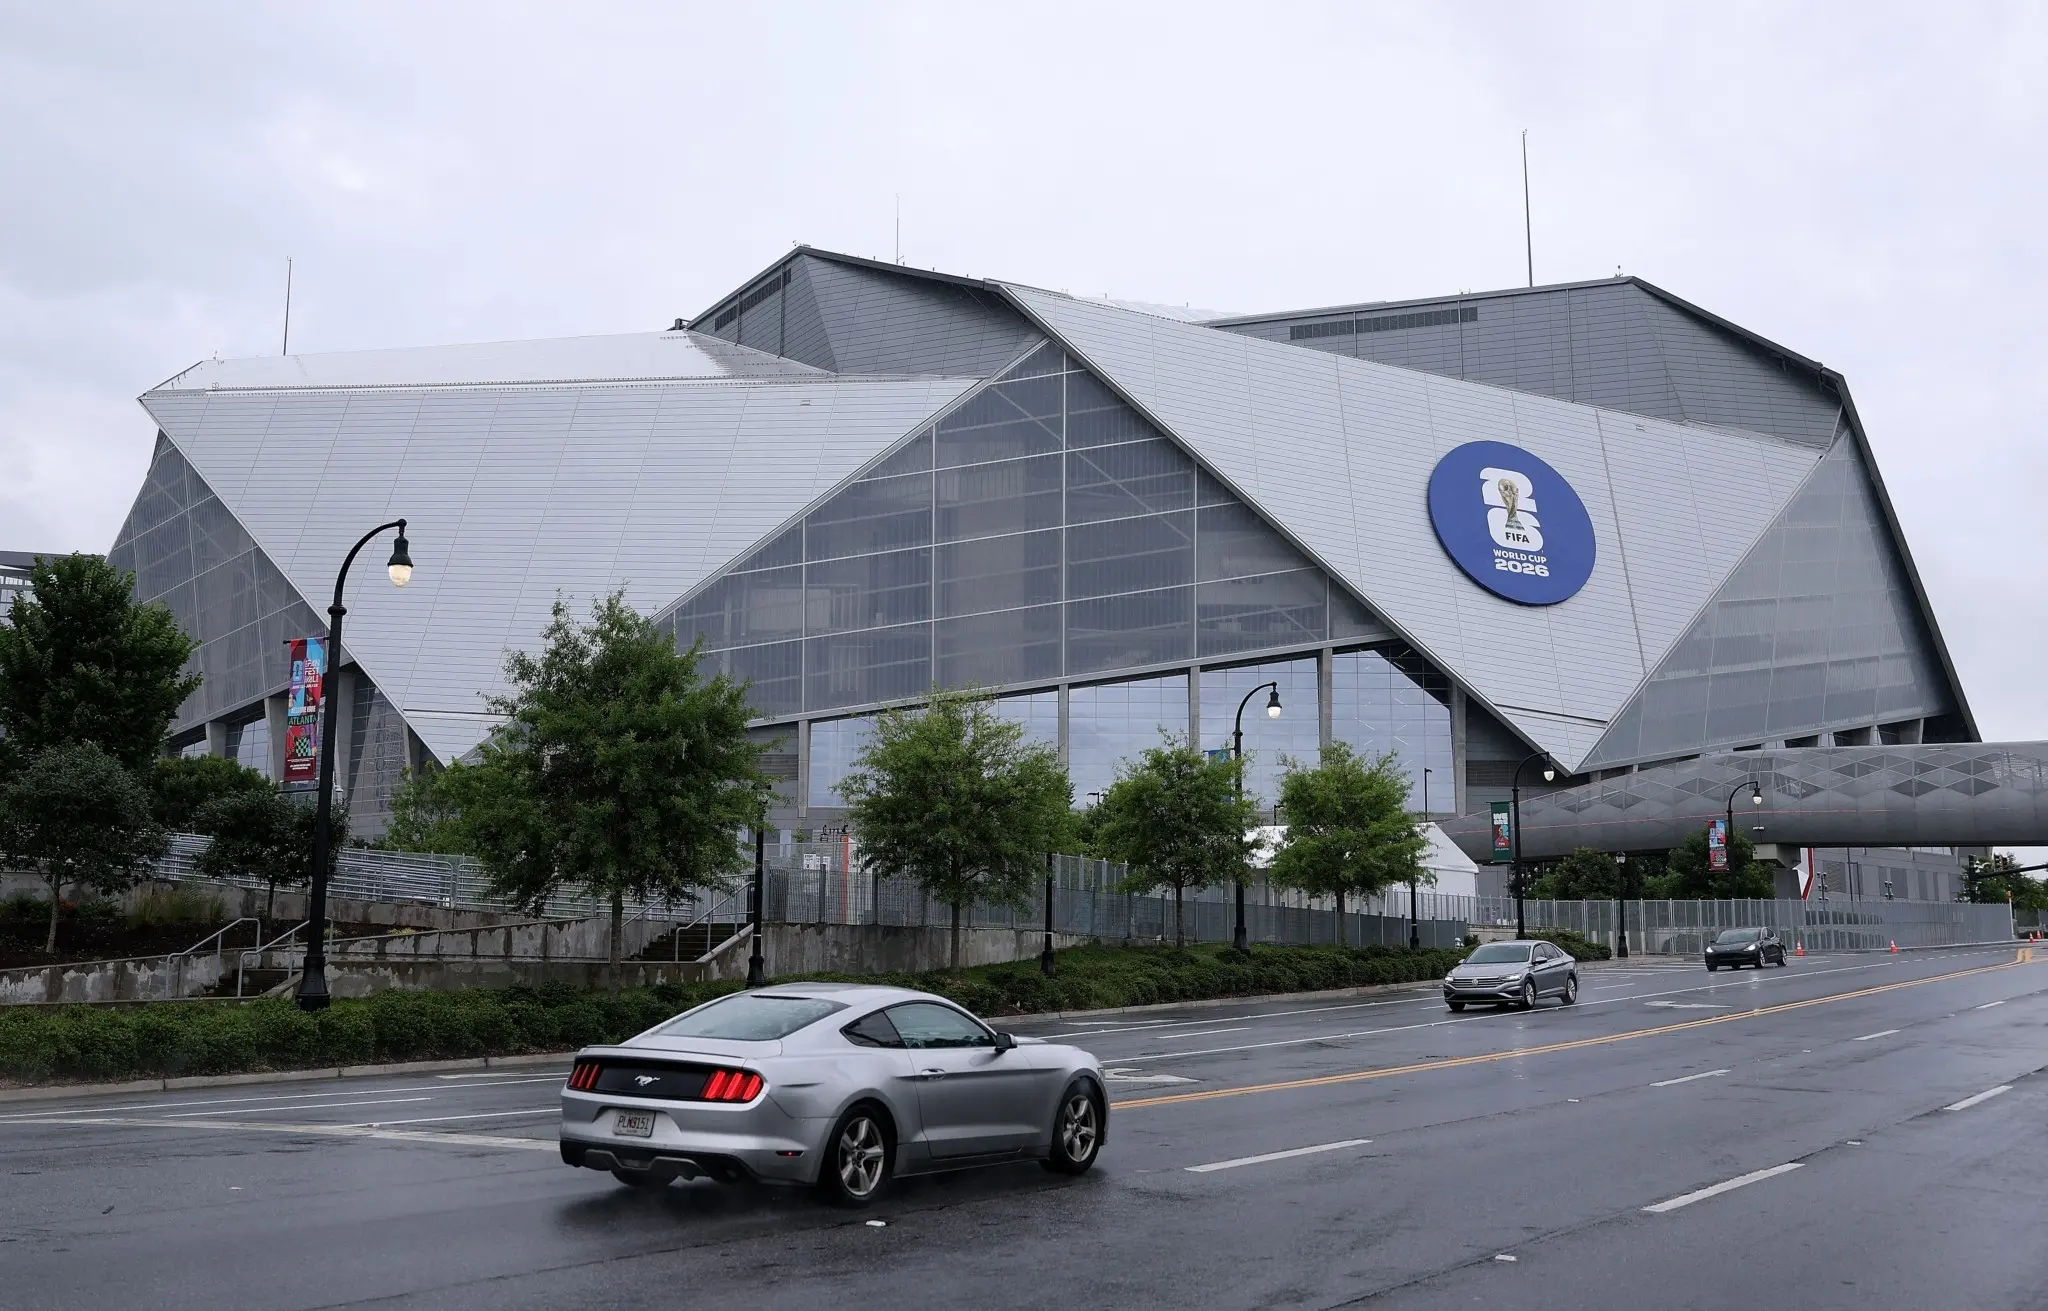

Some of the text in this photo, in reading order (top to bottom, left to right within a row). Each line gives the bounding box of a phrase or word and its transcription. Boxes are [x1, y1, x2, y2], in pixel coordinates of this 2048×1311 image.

[1505, 532, 1530, 543] FIFA
[1493, 549, 1547, 564] WORLD CUP
[1495, 559, 1549, 577] 2026
[289, 715, 316, 725] ATLANTA
